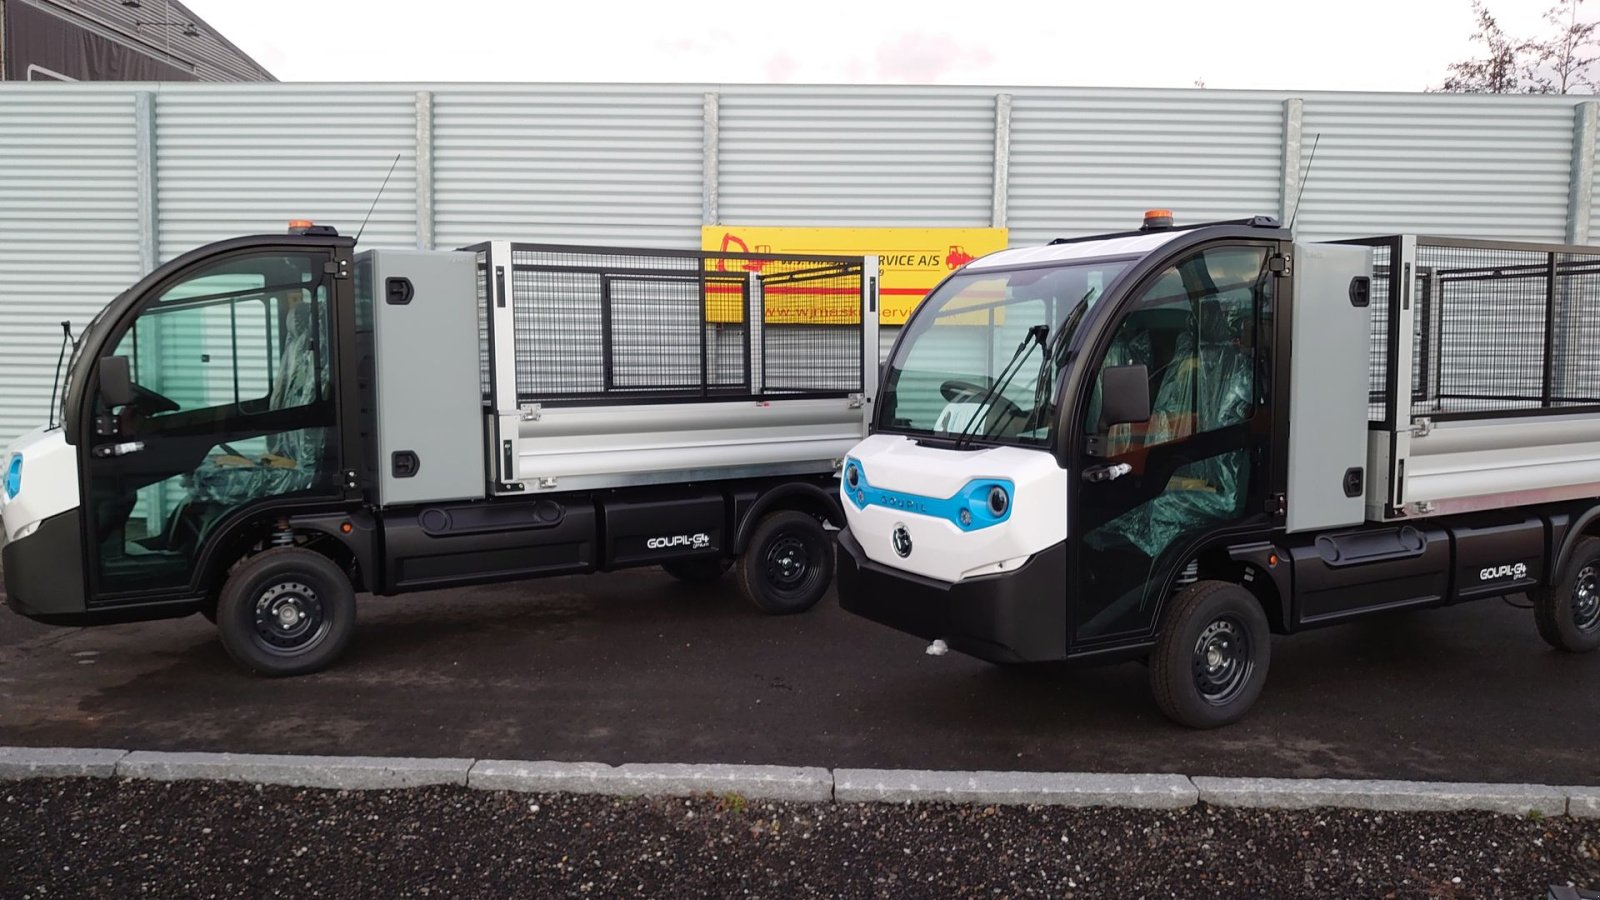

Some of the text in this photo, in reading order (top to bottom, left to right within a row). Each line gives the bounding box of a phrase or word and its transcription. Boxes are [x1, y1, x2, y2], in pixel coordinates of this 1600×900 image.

[879, 255, 940, 266] RVICE A/S
[647, 533, 709, 548] GOUPIL-G4
